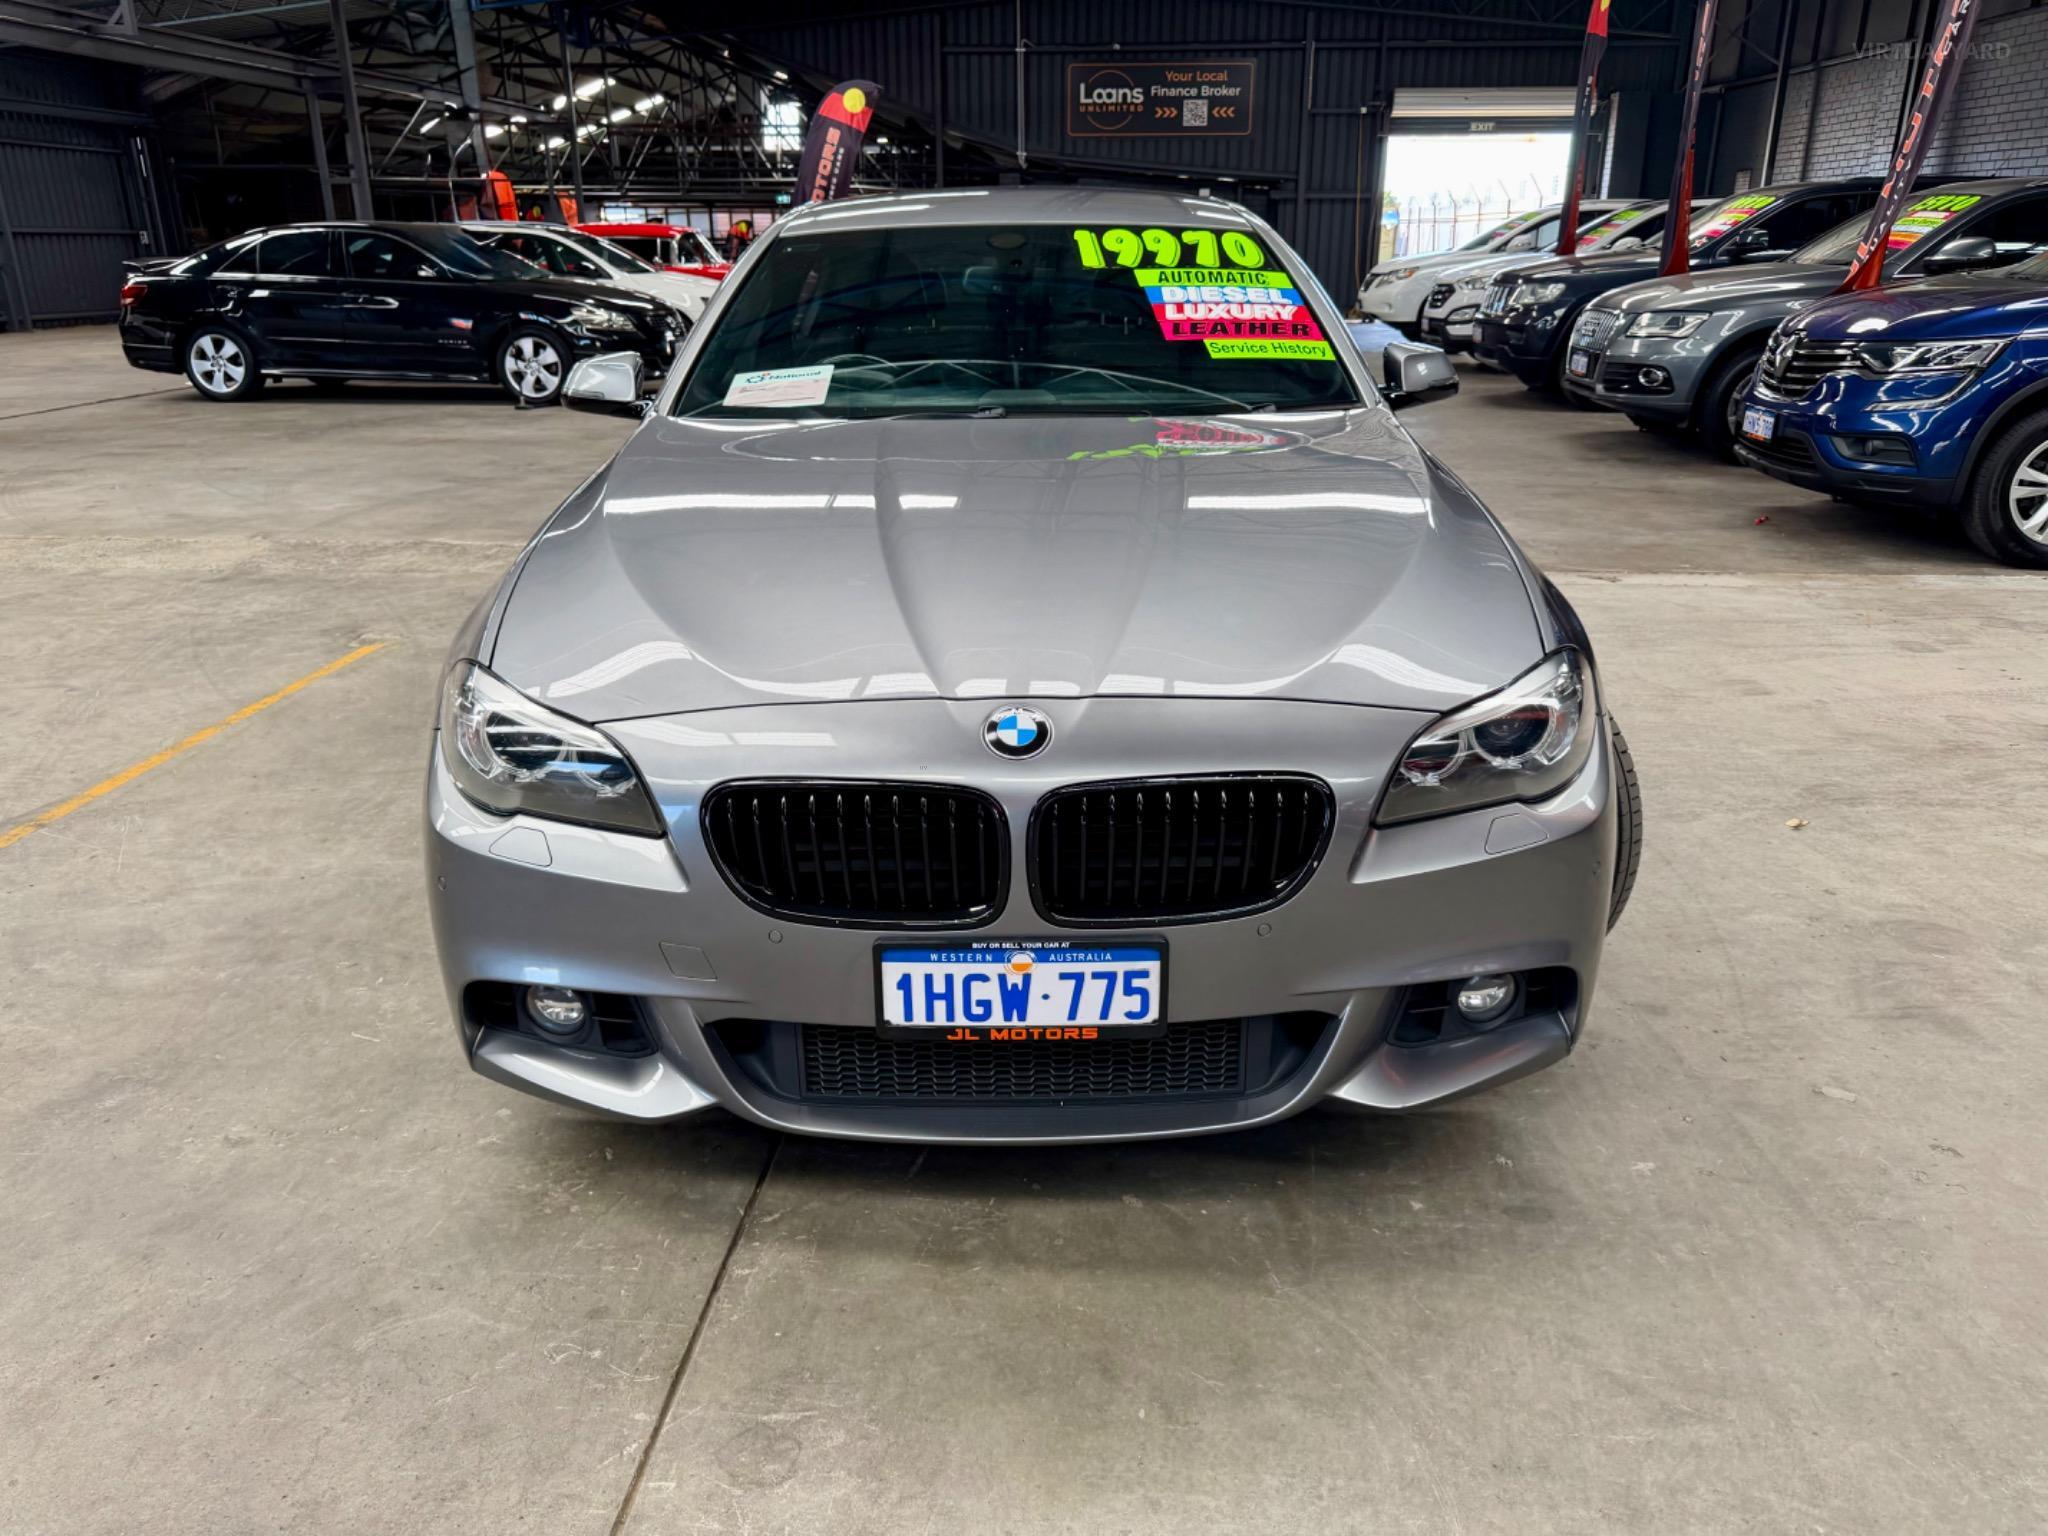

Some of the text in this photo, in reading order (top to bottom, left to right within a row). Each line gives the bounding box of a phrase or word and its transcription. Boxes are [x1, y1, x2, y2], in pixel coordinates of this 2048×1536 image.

[1165, 69, 1228, 81] Your Local
[1080, 82, 1144, 104] Loans
[1151, 84, 1242, 97] Finance Broker
[1079, 104, 1145, 113] UNLIMITED
[1470, 121, 1496, 132] EXIT
[810, 126, 841, 203] OTORS
[1073, 228, 1265, 268] 19970
[1158, 270, 1268, 286] AUTOMATIC
[1161, 286, 1293, 304] DIESEL
[1165, 303, 1299, 321] LUXURY
[1173, 322, 1311, 336] LEATHER
[1210, 342, 1327, 358] Service History
[930, 953, 1113, 962] WESTERN AUSTRALIA
[946, 1027, 1099, 1040] JL MOTORS
